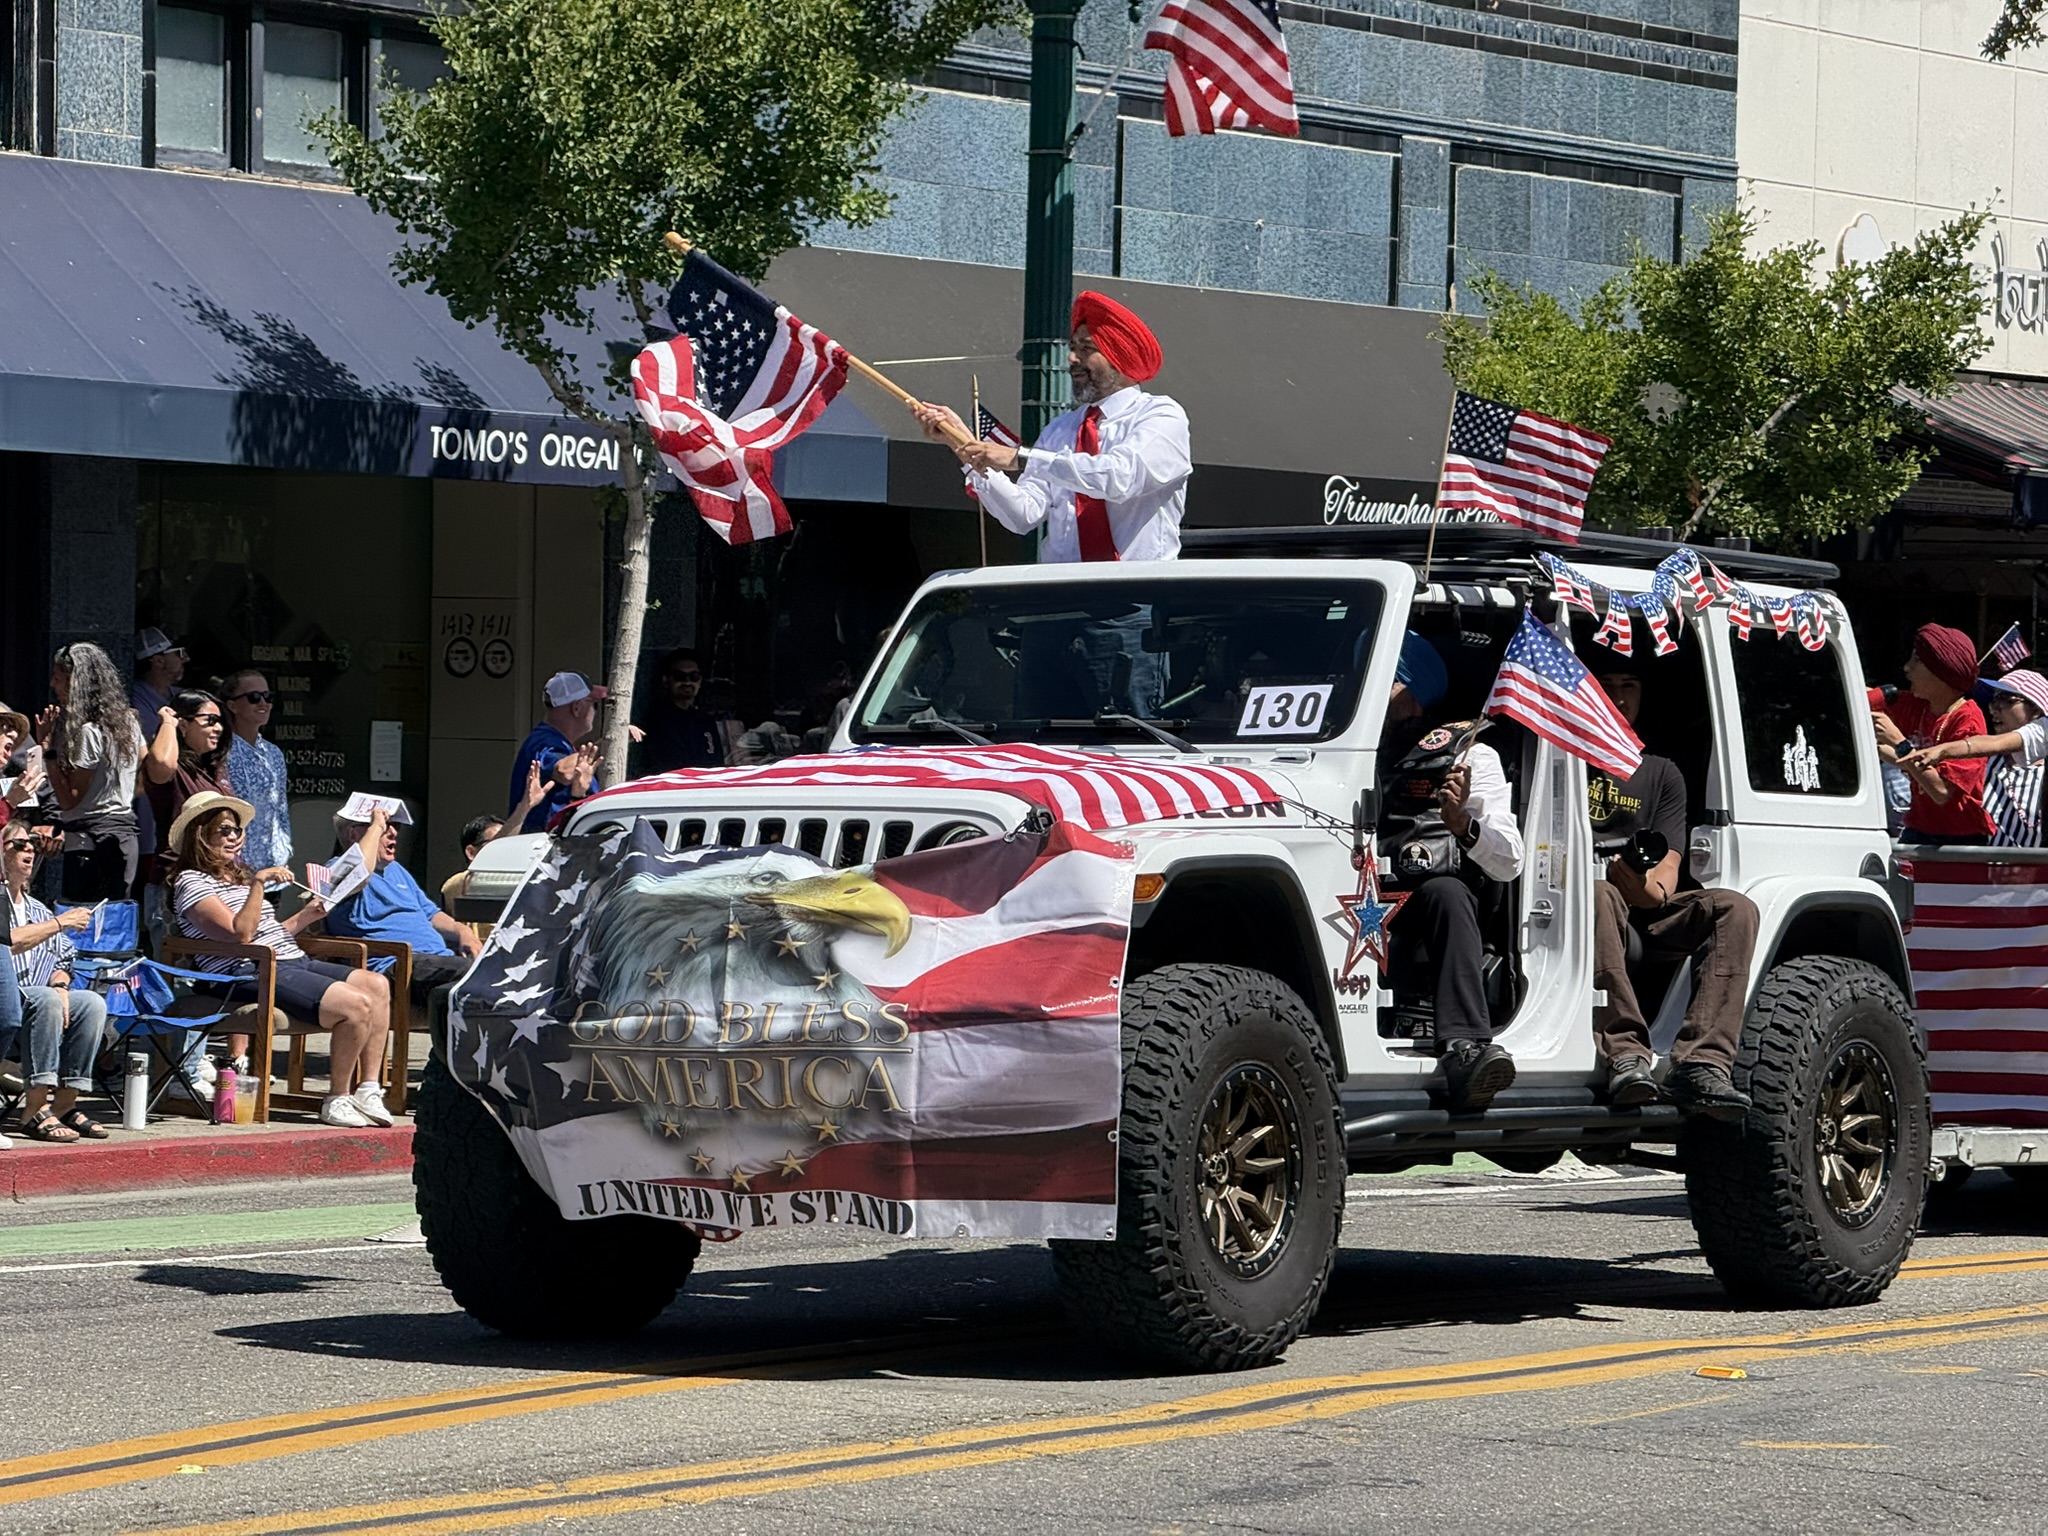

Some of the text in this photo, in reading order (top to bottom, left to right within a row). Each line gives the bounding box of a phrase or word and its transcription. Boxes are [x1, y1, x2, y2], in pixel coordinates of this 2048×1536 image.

[430, 426, 643, 471] TOMO'S ORGA
[441, 612, 511, 637] 1413 1411
[252, 645, 290, 662] ORGANIC
[1244, 691, 1322, 729] 130
[275, 725, 316, 740] MASSAGE
[285, 750, 345, 768] 0-521-8778
[1333, 968, 1371, 1001] Jeep
[567, 998, 911, 1045] GOD BLESS
[1338, 1003, 1369, 1011] ANGLER
[583, 1052, 911, 1113] AMERICA
[577, 1179, 914, 1236] UNITED WE STAND
